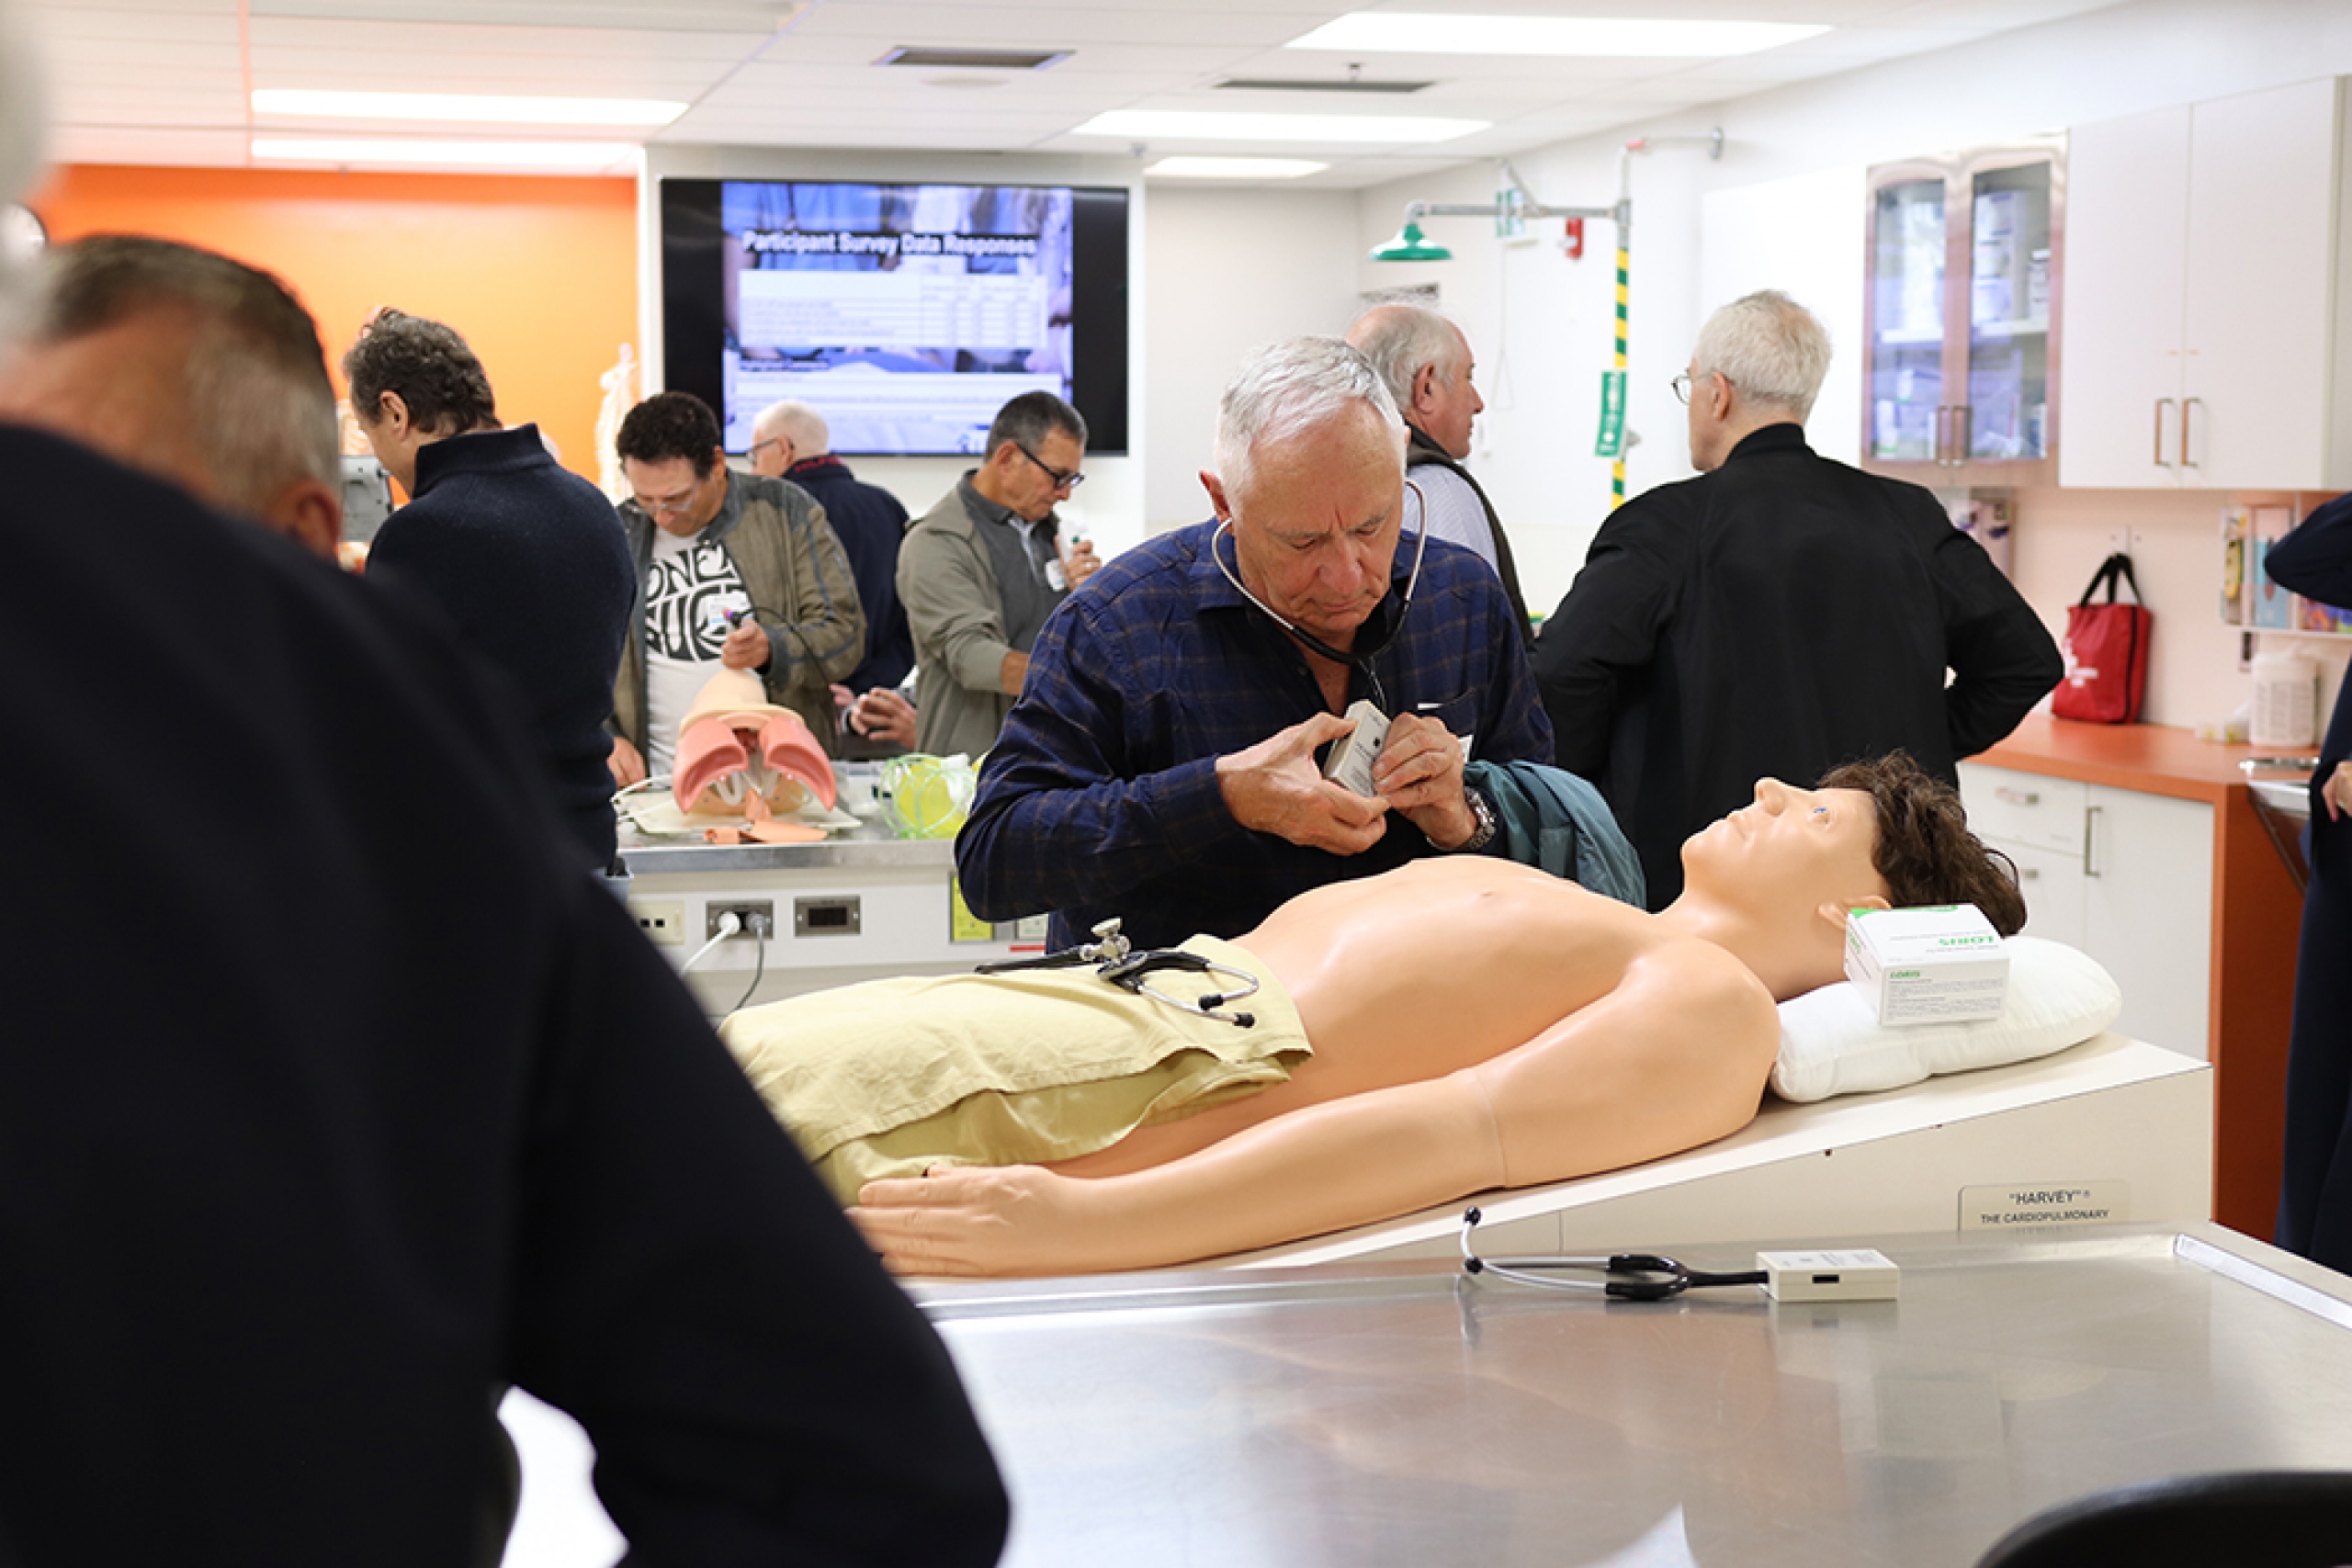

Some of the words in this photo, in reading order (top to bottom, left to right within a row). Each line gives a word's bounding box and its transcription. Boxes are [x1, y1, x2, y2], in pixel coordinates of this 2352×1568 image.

[743, 231, 835, 255] Participant
[840, 231, 899, 258] Survey
[902, 233, 941, 254] Data
[944, 234, 1037, 256] Responses
[1980, 1213, 2000, 1224] THE
[2003, 1209, 2110, 1224] CARDIOPULMONARY
